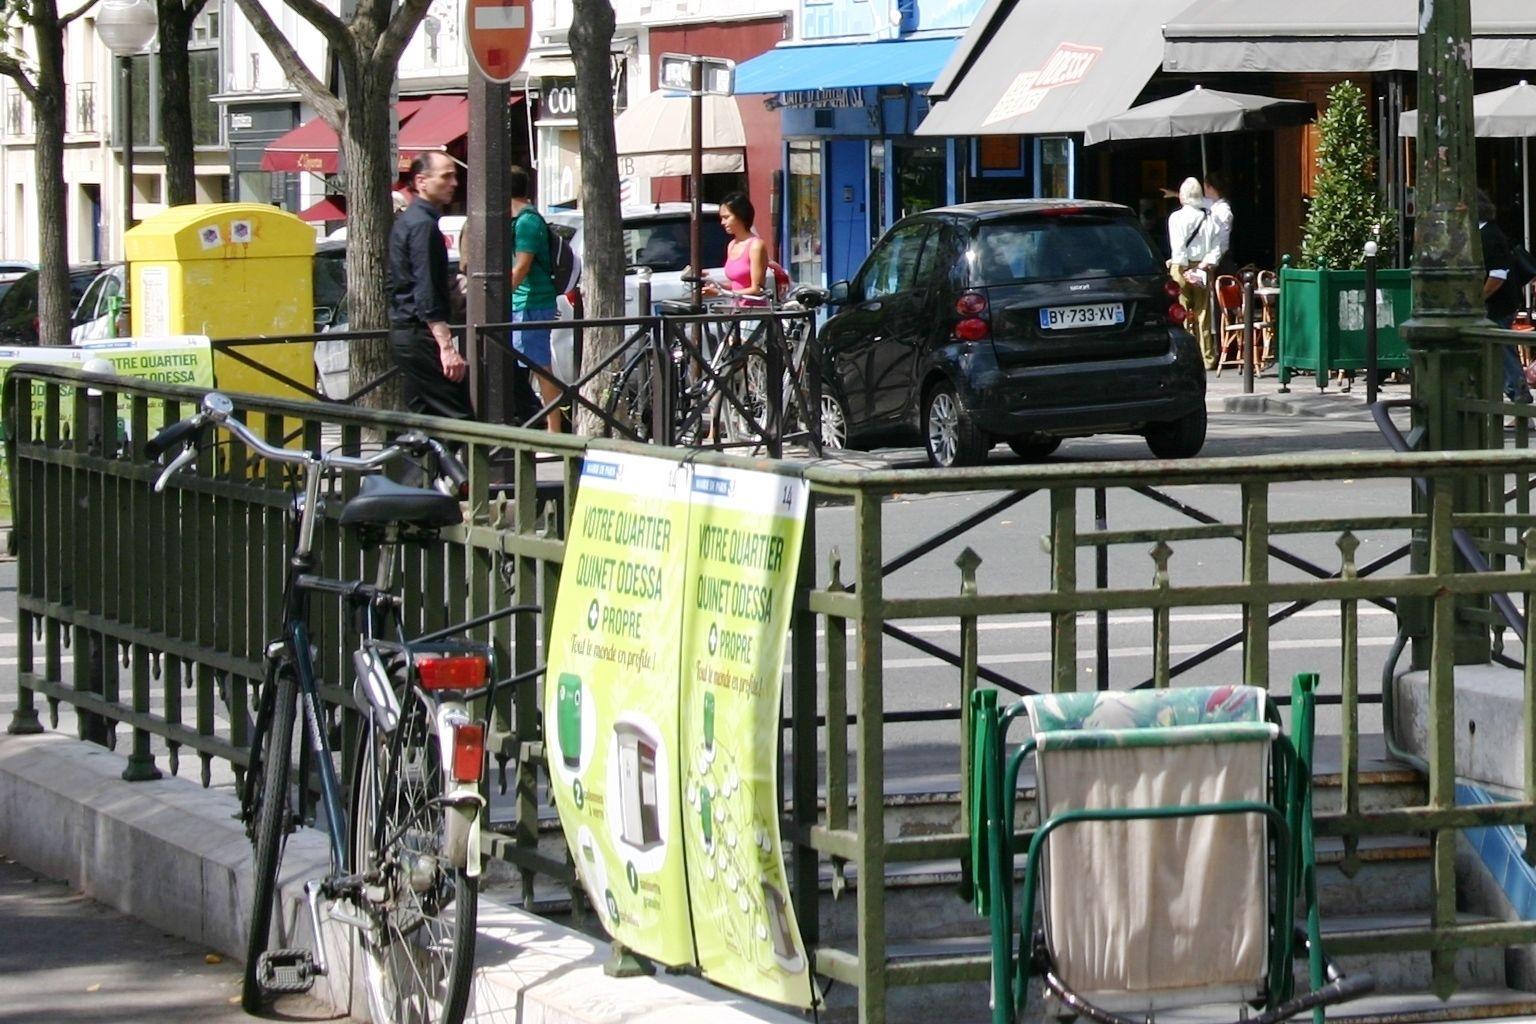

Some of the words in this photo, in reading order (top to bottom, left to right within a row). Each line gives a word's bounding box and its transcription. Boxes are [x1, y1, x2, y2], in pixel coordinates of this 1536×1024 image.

[140, 354, 197, 369] QUARTIER
[783, 486, 792, 510] 14
[583, 506, 615, 539] VOTRE
[615, 511, 671, 552] QUARTIER
[699, 523, 729, 561] VOTRE
[729, 530, 784, 572] QUARTIER
[576, 553, 616, 592] QUINET
[617, 557, 662, 601] ODESSA
[697, 574, 731, 613] QUINET
[731, 580, 773, 623] ODESSA
[602, 606, 642, 639] PROPRE
[571, 634, 585, 662] Tout
[586, 643, 593, 661] le
[593, 644, 616, 662] monde
[617, 651, 627, 665] en
[627, 649, 651, 673] profite
[720, 629, 753, 664] PROPRE
[714, 667, 731, 687] monde
[575, 784, 582, 804] 2
